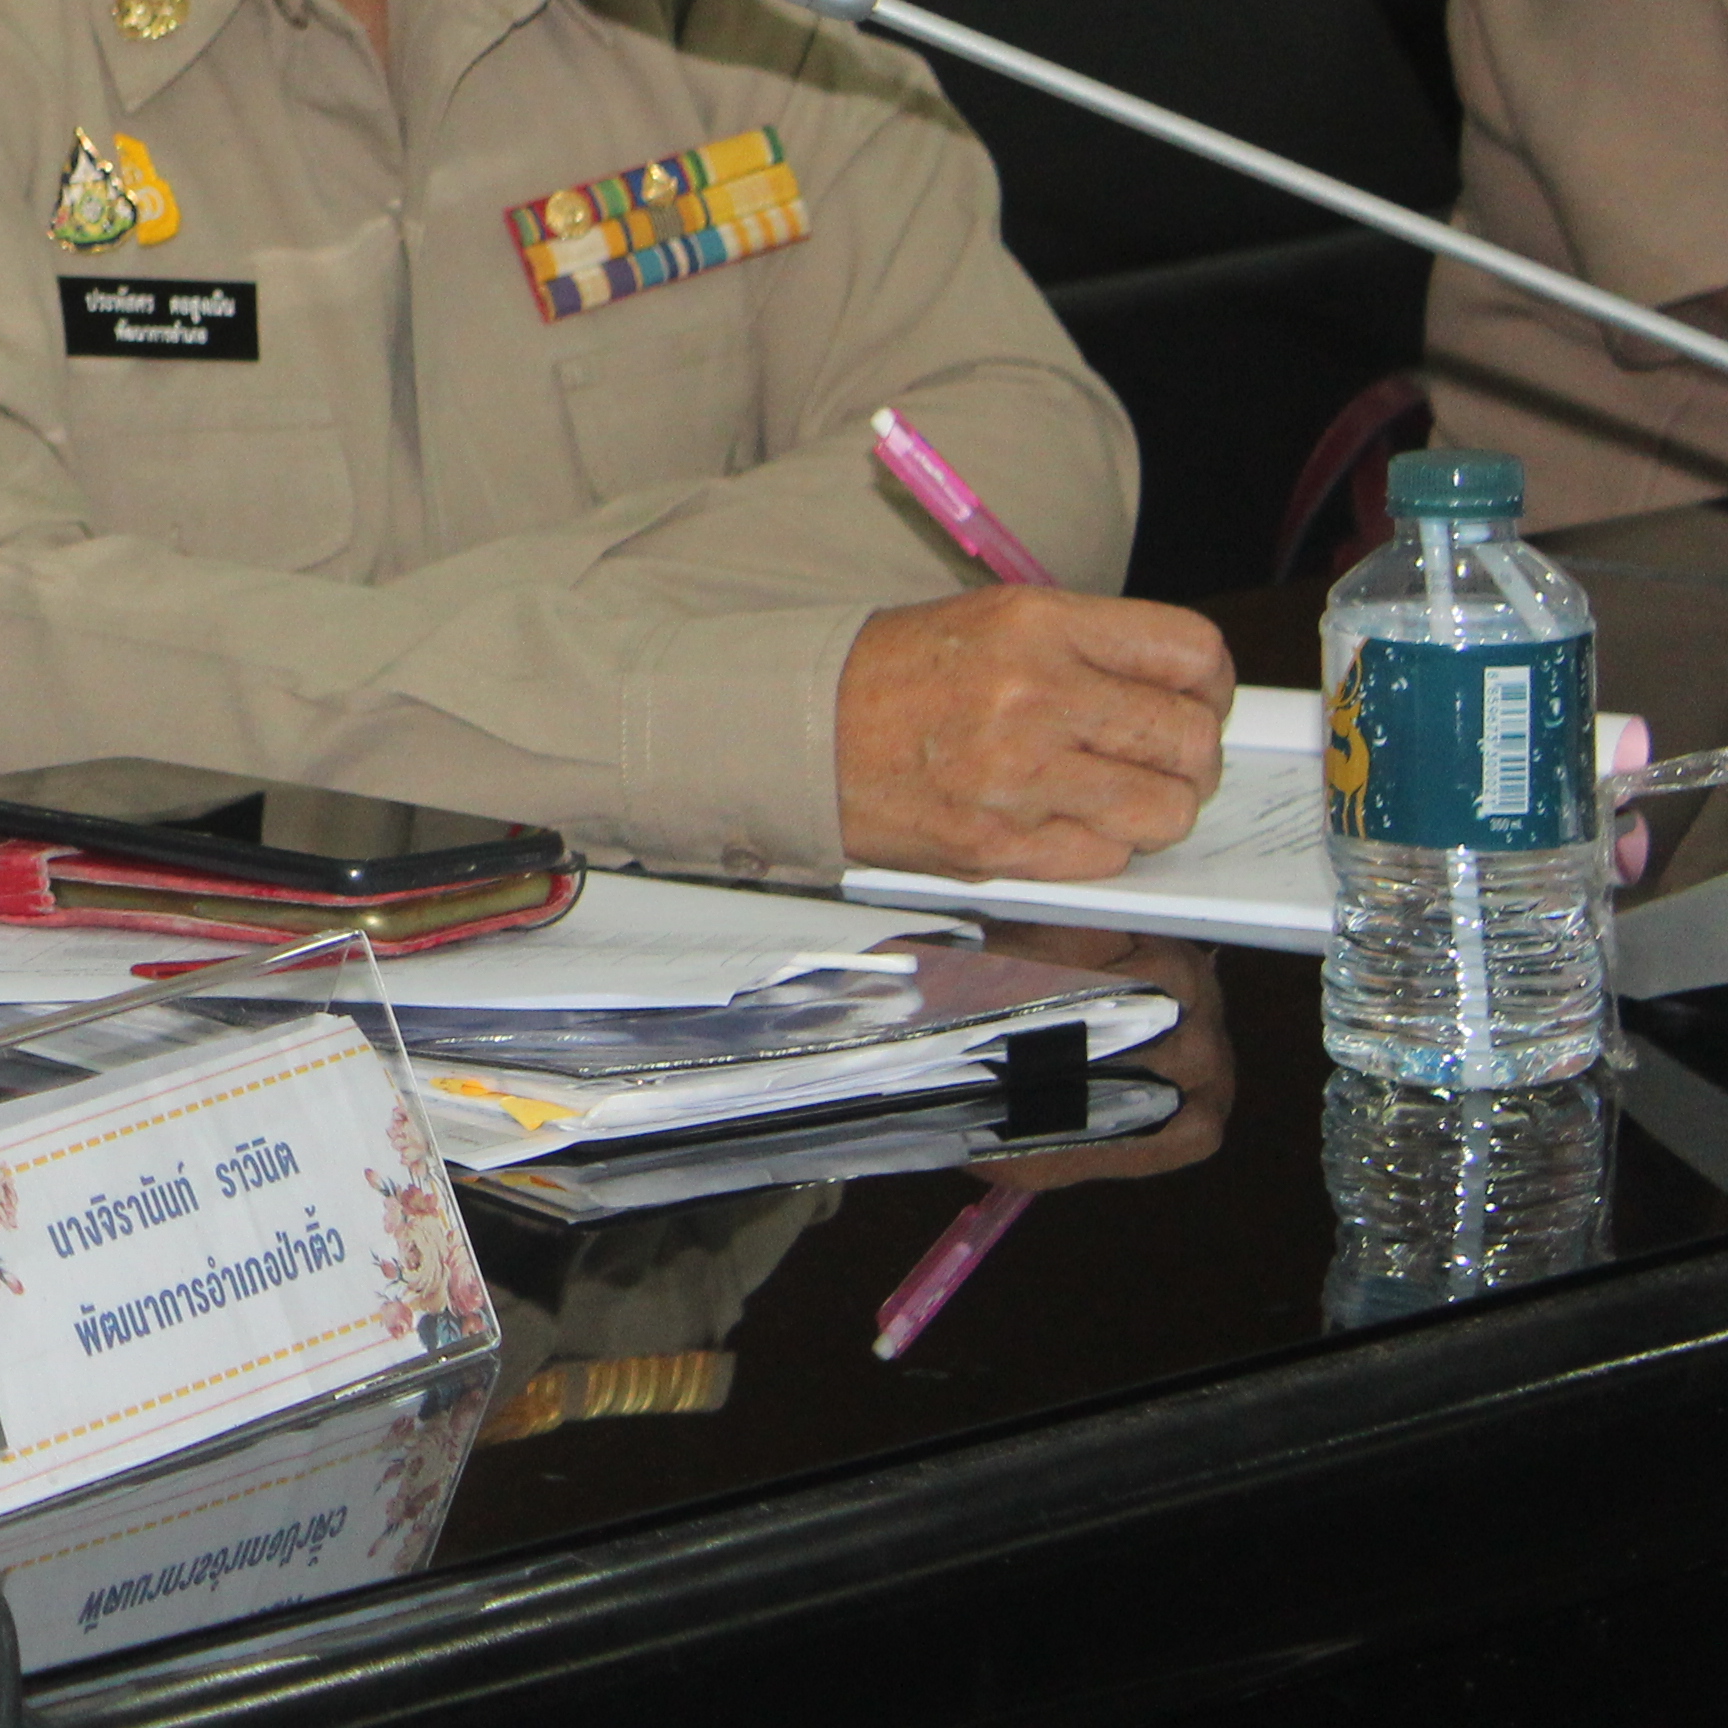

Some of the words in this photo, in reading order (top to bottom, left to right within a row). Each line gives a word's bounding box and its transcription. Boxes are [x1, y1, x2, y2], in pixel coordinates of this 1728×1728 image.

[47, 1160, 200, 1259] นางจิรานันท์
[214, 1136, 301, 1199] ราวินิต
[73, 1204, 347, 1357] พัฒนาการอำเภอป่าติ้ว
